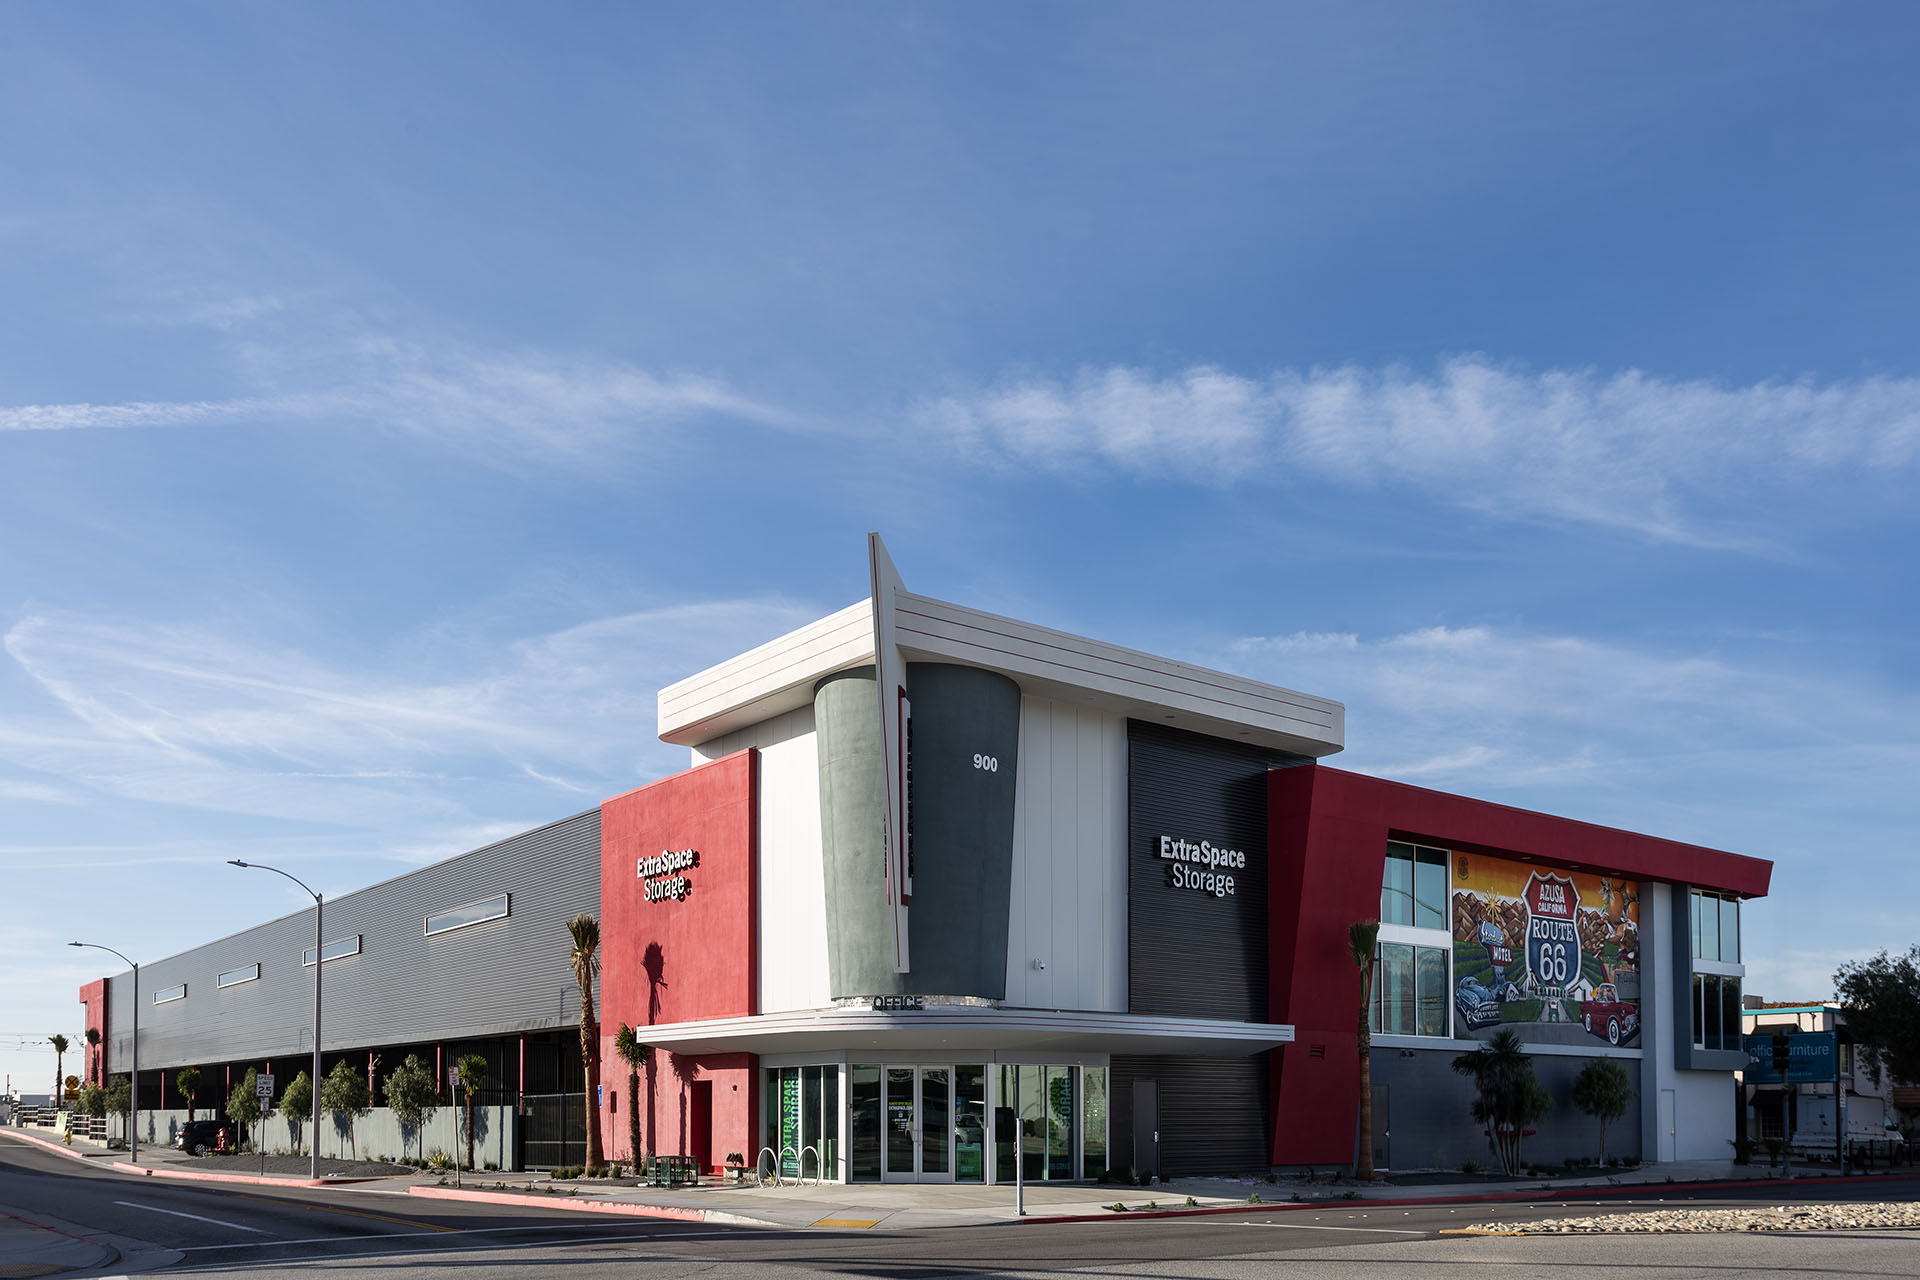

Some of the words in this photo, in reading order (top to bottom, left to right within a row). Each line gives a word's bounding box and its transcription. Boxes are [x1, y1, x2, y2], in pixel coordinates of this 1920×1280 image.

[973, 753, 998, 772] 900
[637, 848, 693, 878] ExtraSpace
[1160, 835, 1246, 870] ExtraSpace
[643, 876, 685, 901] Storage
[1172, 862, 1235, 898] Storage
[1539, 883, 1566, 904] AZUSA
[1538, 902, 1568, 915] CALIFORNIA
[1532, 918, 1574, 942] ROUTE
[1493, 946, 1513, 962] MOTEL
[1540, 942, 1567, 981] 66
[873, 995, 923, 1010] OFFICE
[1750, 1043, 1775, 1057] offic
[1787, 1043, 1830, 1056] urniture
[258, 1086, 272, 1095] 25
[782, 1116, 792, 1156] EXTRA
